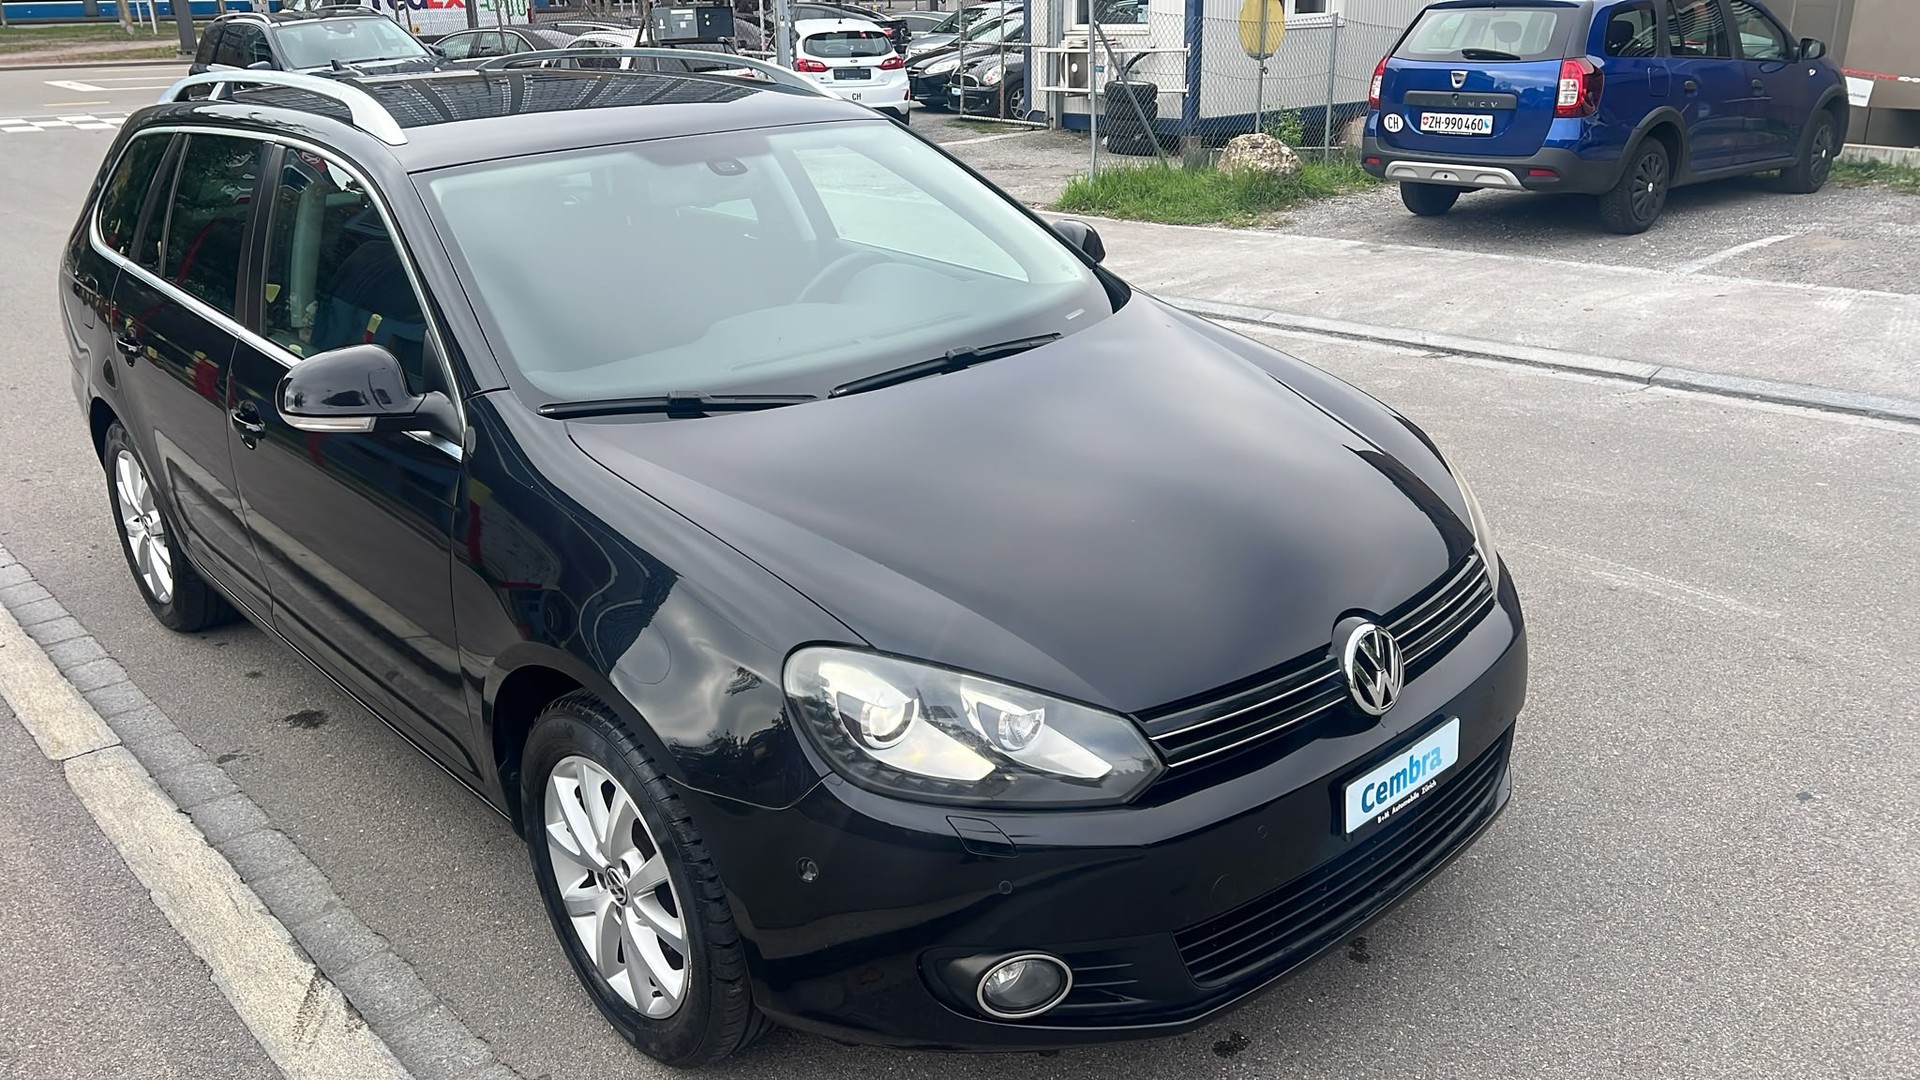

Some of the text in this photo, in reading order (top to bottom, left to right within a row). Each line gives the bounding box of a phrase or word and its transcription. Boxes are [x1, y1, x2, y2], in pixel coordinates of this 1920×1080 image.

[852, 93, 862, 101] CH
[1387, 116, 1399, 129] CH
[1361, 746, 1442, 813] Cembra
[1391, 791, 1420, 814] Automobile
